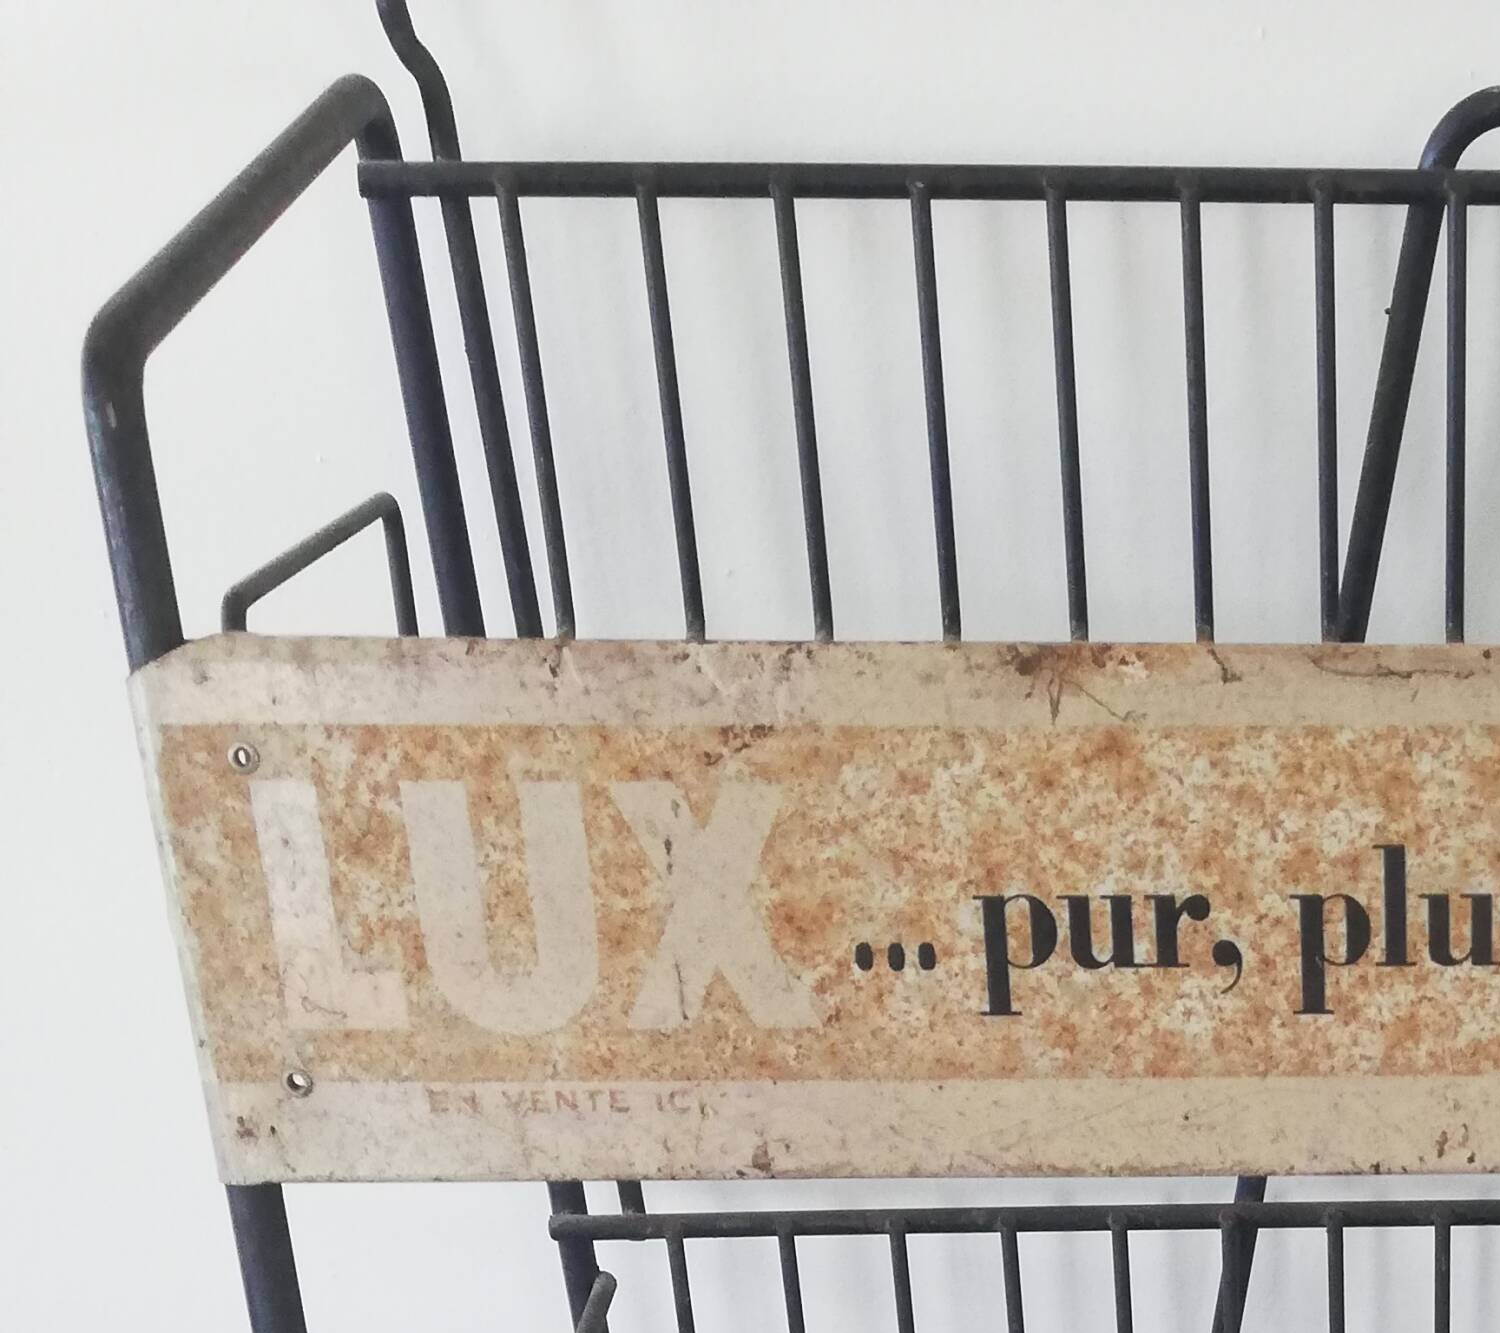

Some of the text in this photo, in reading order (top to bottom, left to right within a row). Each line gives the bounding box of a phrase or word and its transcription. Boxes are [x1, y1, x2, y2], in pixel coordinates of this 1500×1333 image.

[249, 779, 823, 1035] LUX
[973, 893, 1244, 1016] pur,
[502, 1087, 632, 1116] VENTE
